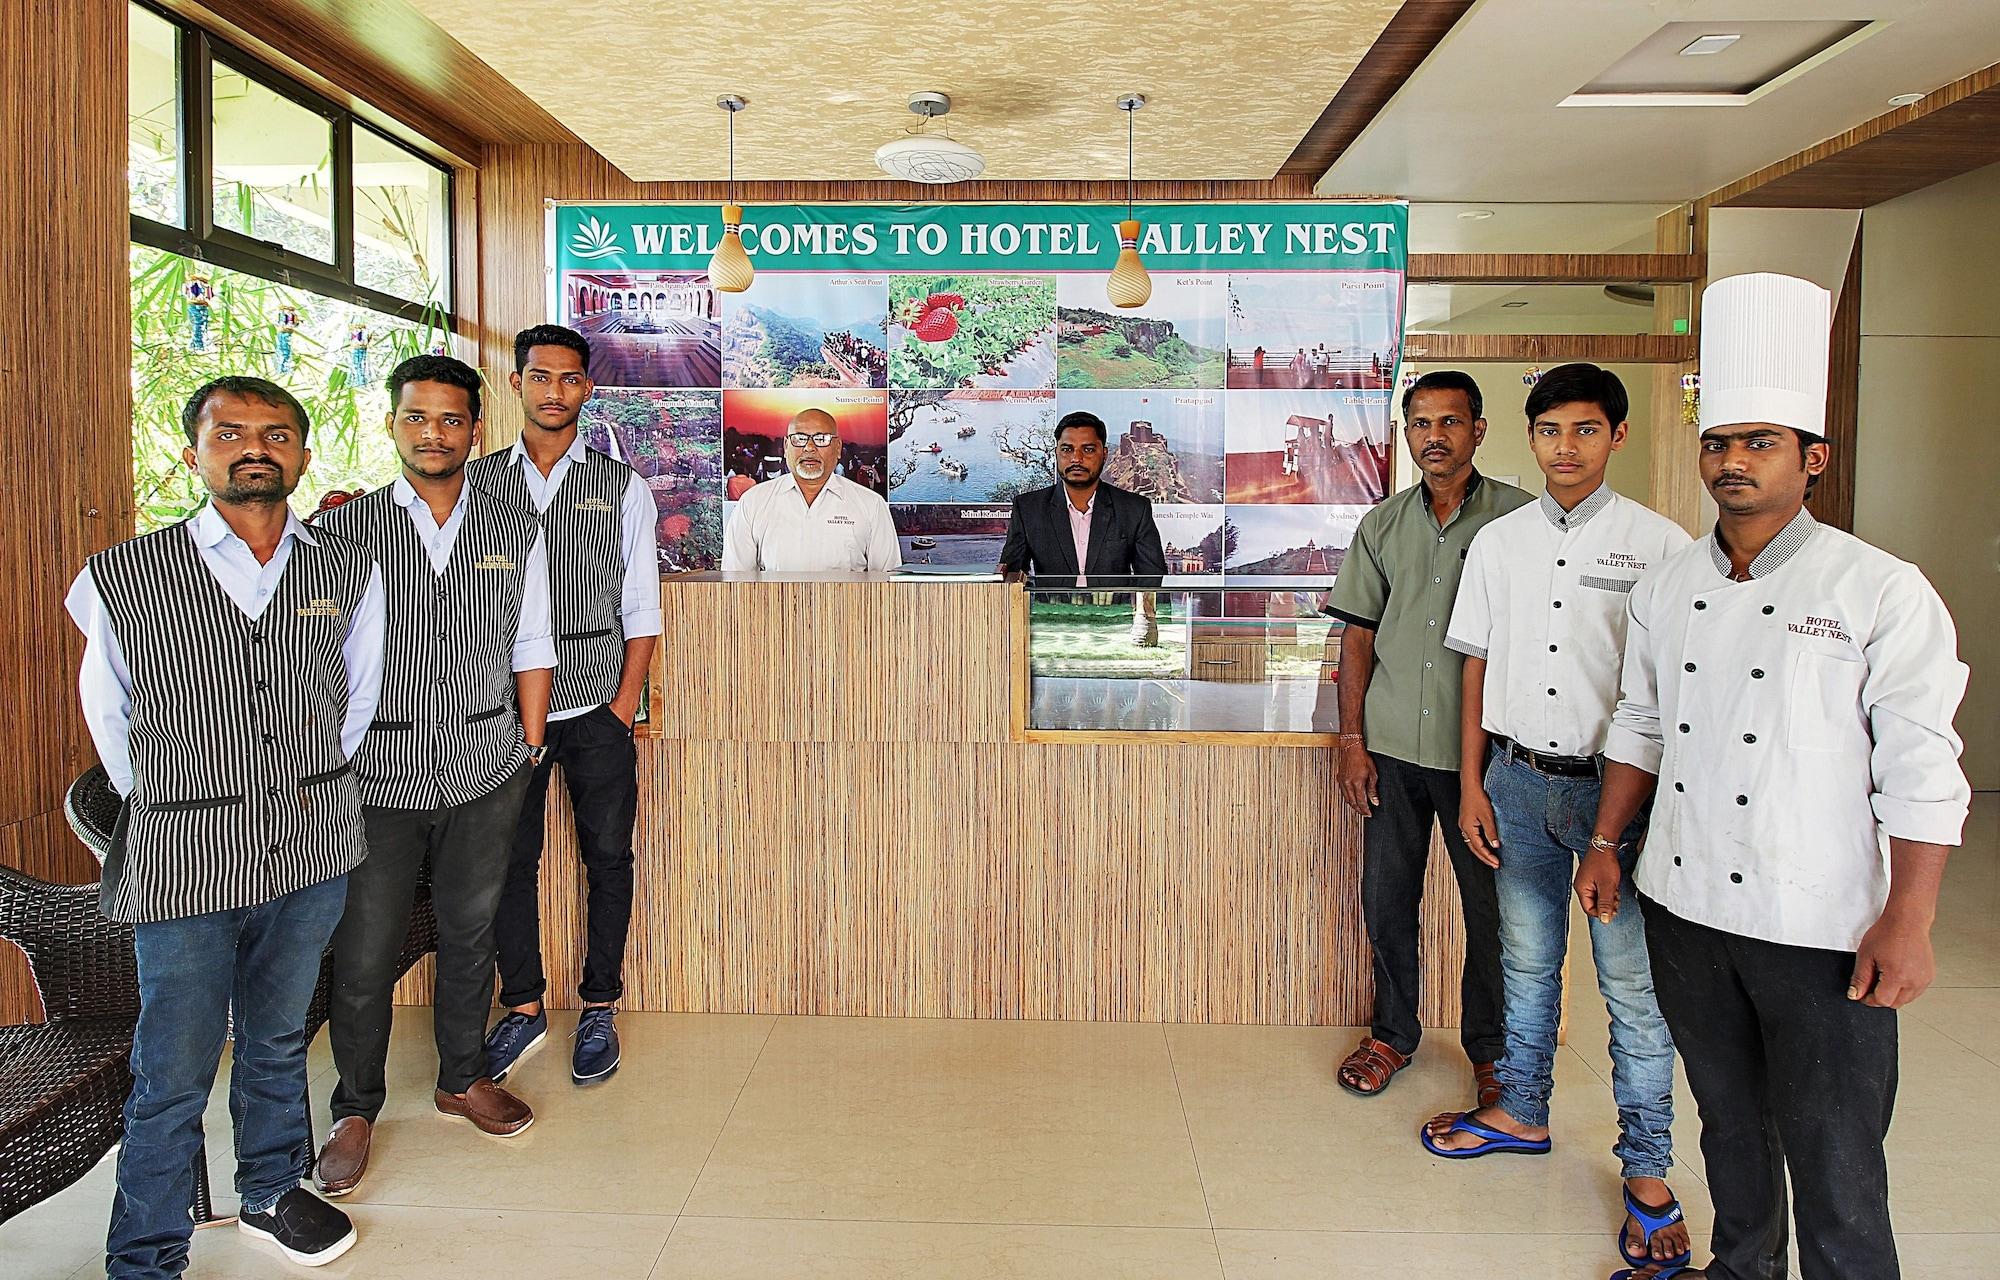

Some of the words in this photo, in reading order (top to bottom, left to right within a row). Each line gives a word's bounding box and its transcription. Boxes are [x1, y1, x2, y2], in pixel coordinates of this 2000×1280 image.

[889, 222, 949, 256] TO
[960, 222, 1101, 256] HOTEL
[1284, 222, 1396, 255] NEST
[690, 282, 714, 291] Temple
[854, 278, 867, 286] Seat
[867, 278, 883, 286] Point
[988, 279, 1019, 287] Strawberry
[1195, 278, 1213, 286] Point
[1363, 281, 1385, 289] Point
[685, 399, 716, 407] Waterfall
[1344, 397, 1365, 405] Table
[1366, 397, 1388, 405] Land
[961, 510, 981, 518] Mini
[1176, 511, 1199, 520] Temple
[1200, 511, 1214, 519] Wai
[1330, 512, 1359, 521] Sydney
[1609, 552, 1636, 561] HOTEL
[1596, 558, 1626, 568] VALLEY
[1627, 561, 1647, 570] NEST
[1805, 616, 1841, 630] HOTEL
[1787, 623, 1827, 637] VALLEY
[1828, 630, 1853, 644] NEST
